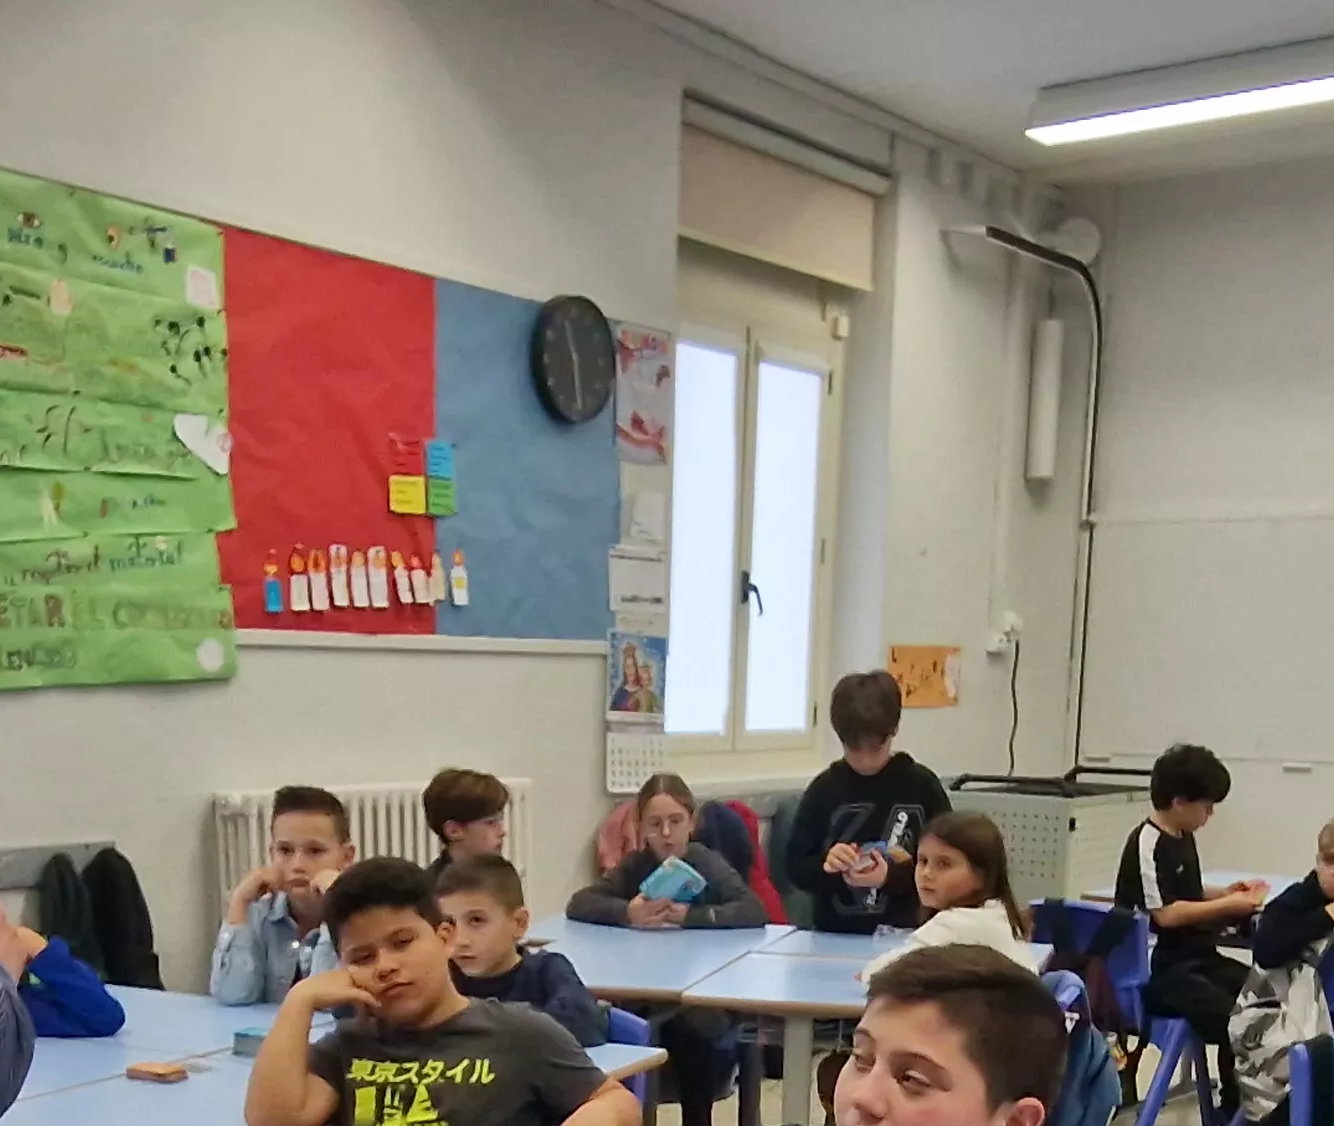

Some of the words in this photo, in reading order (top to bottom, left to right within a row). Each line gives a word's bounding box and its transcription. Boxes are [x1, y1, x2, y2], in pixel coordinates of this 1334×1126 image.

[346, 1058, 496, 1084] 東京スタイル
